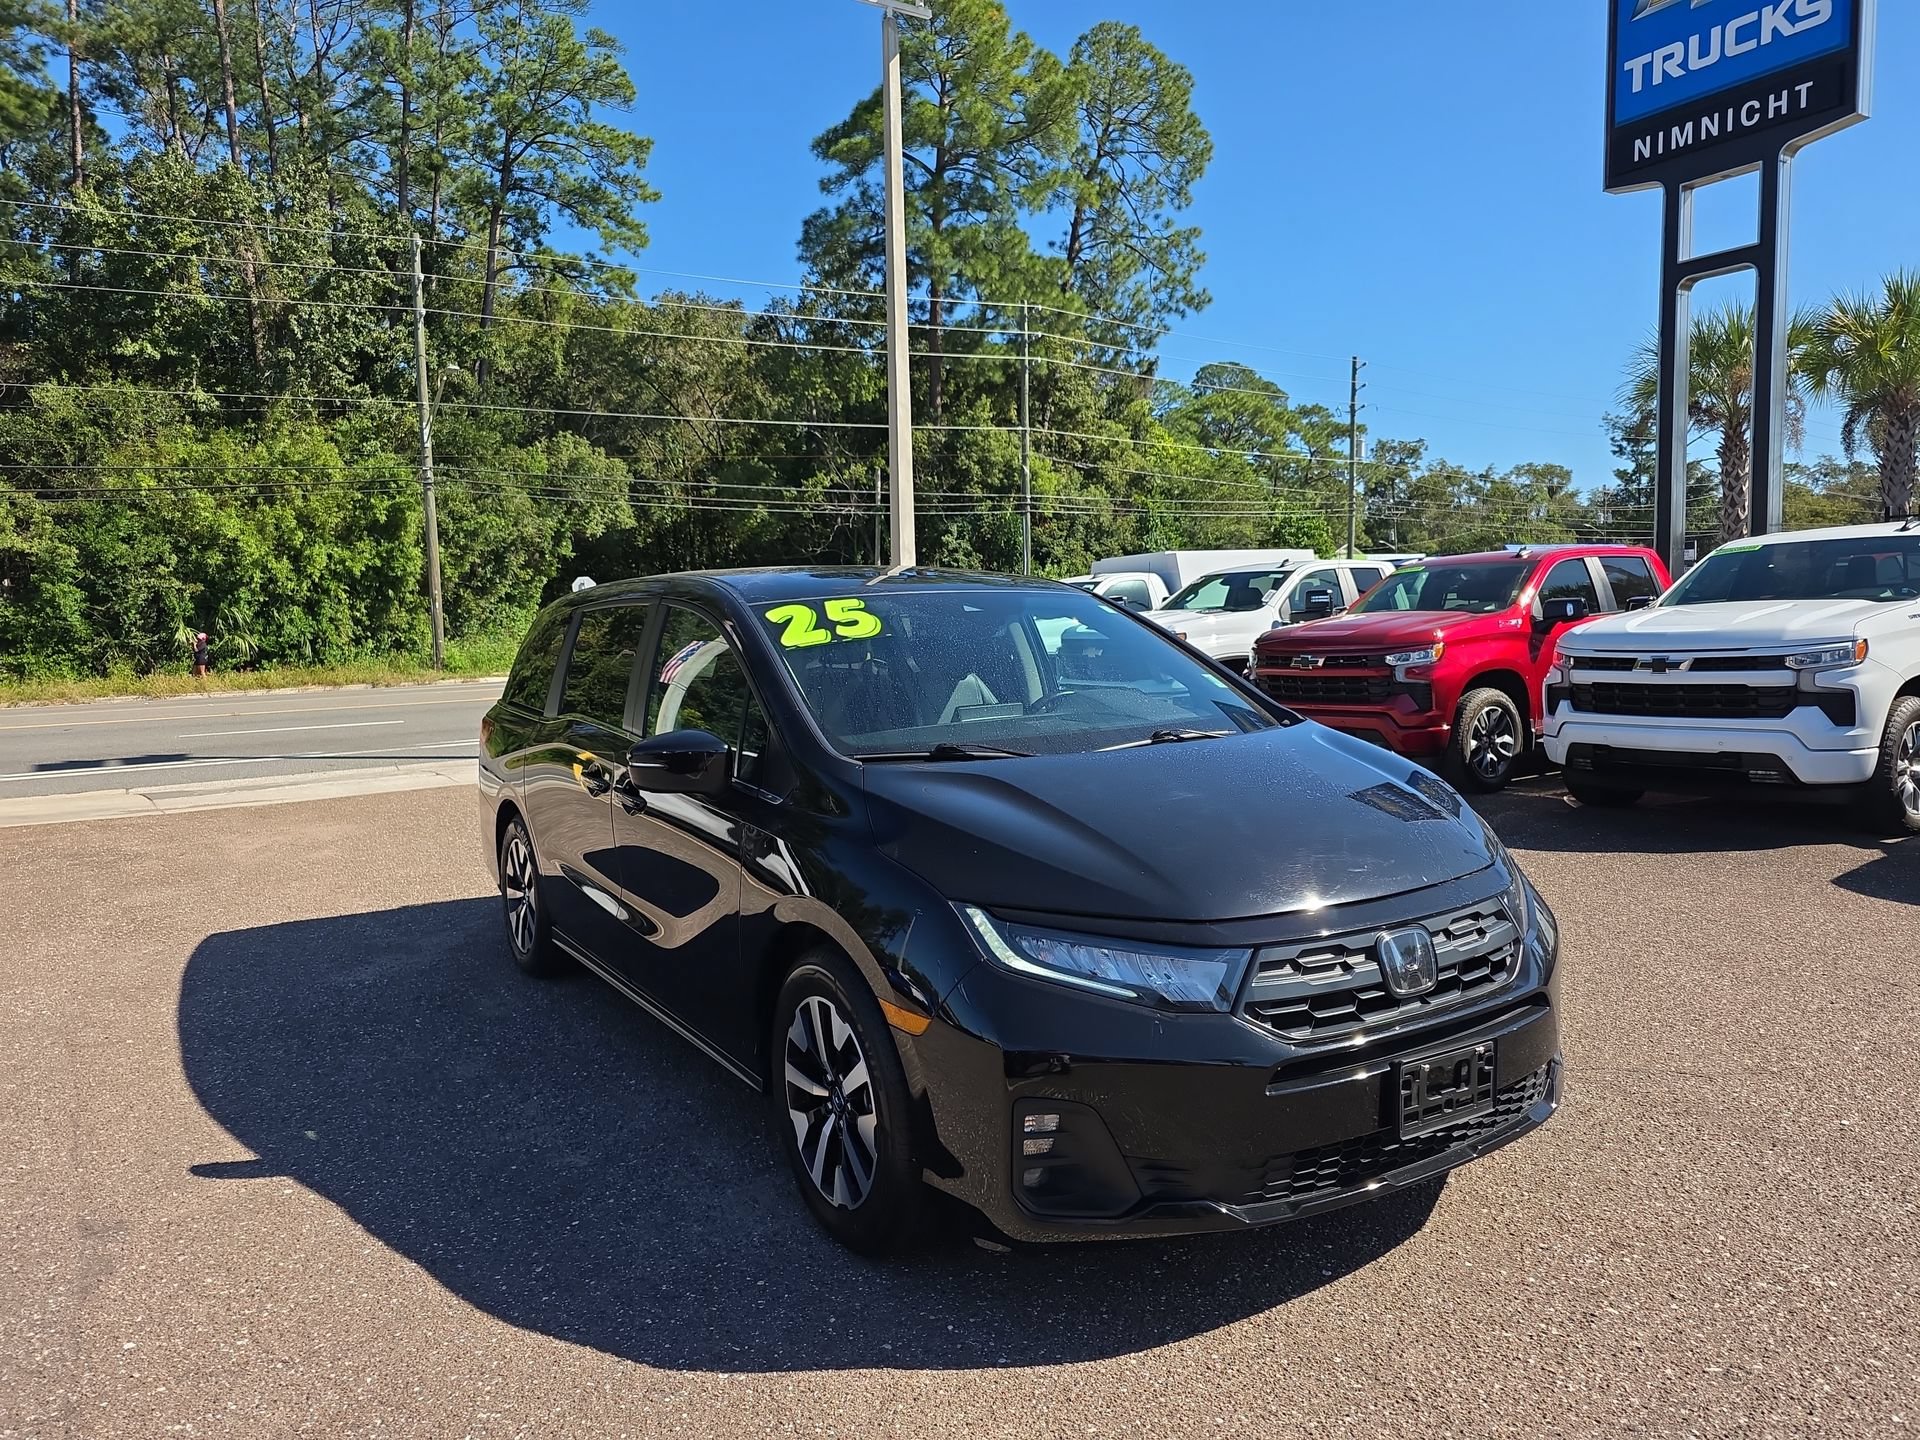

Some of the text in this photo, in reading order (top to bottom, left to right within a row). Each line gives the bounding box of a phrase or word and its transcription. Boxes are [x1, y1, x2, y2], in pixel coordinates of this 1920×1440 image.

[1624, 0, 1832, 93] TRUCKS
[1633, 81, 1814, 162] NIMNICHT
[765, 598, 882, 648] 25
